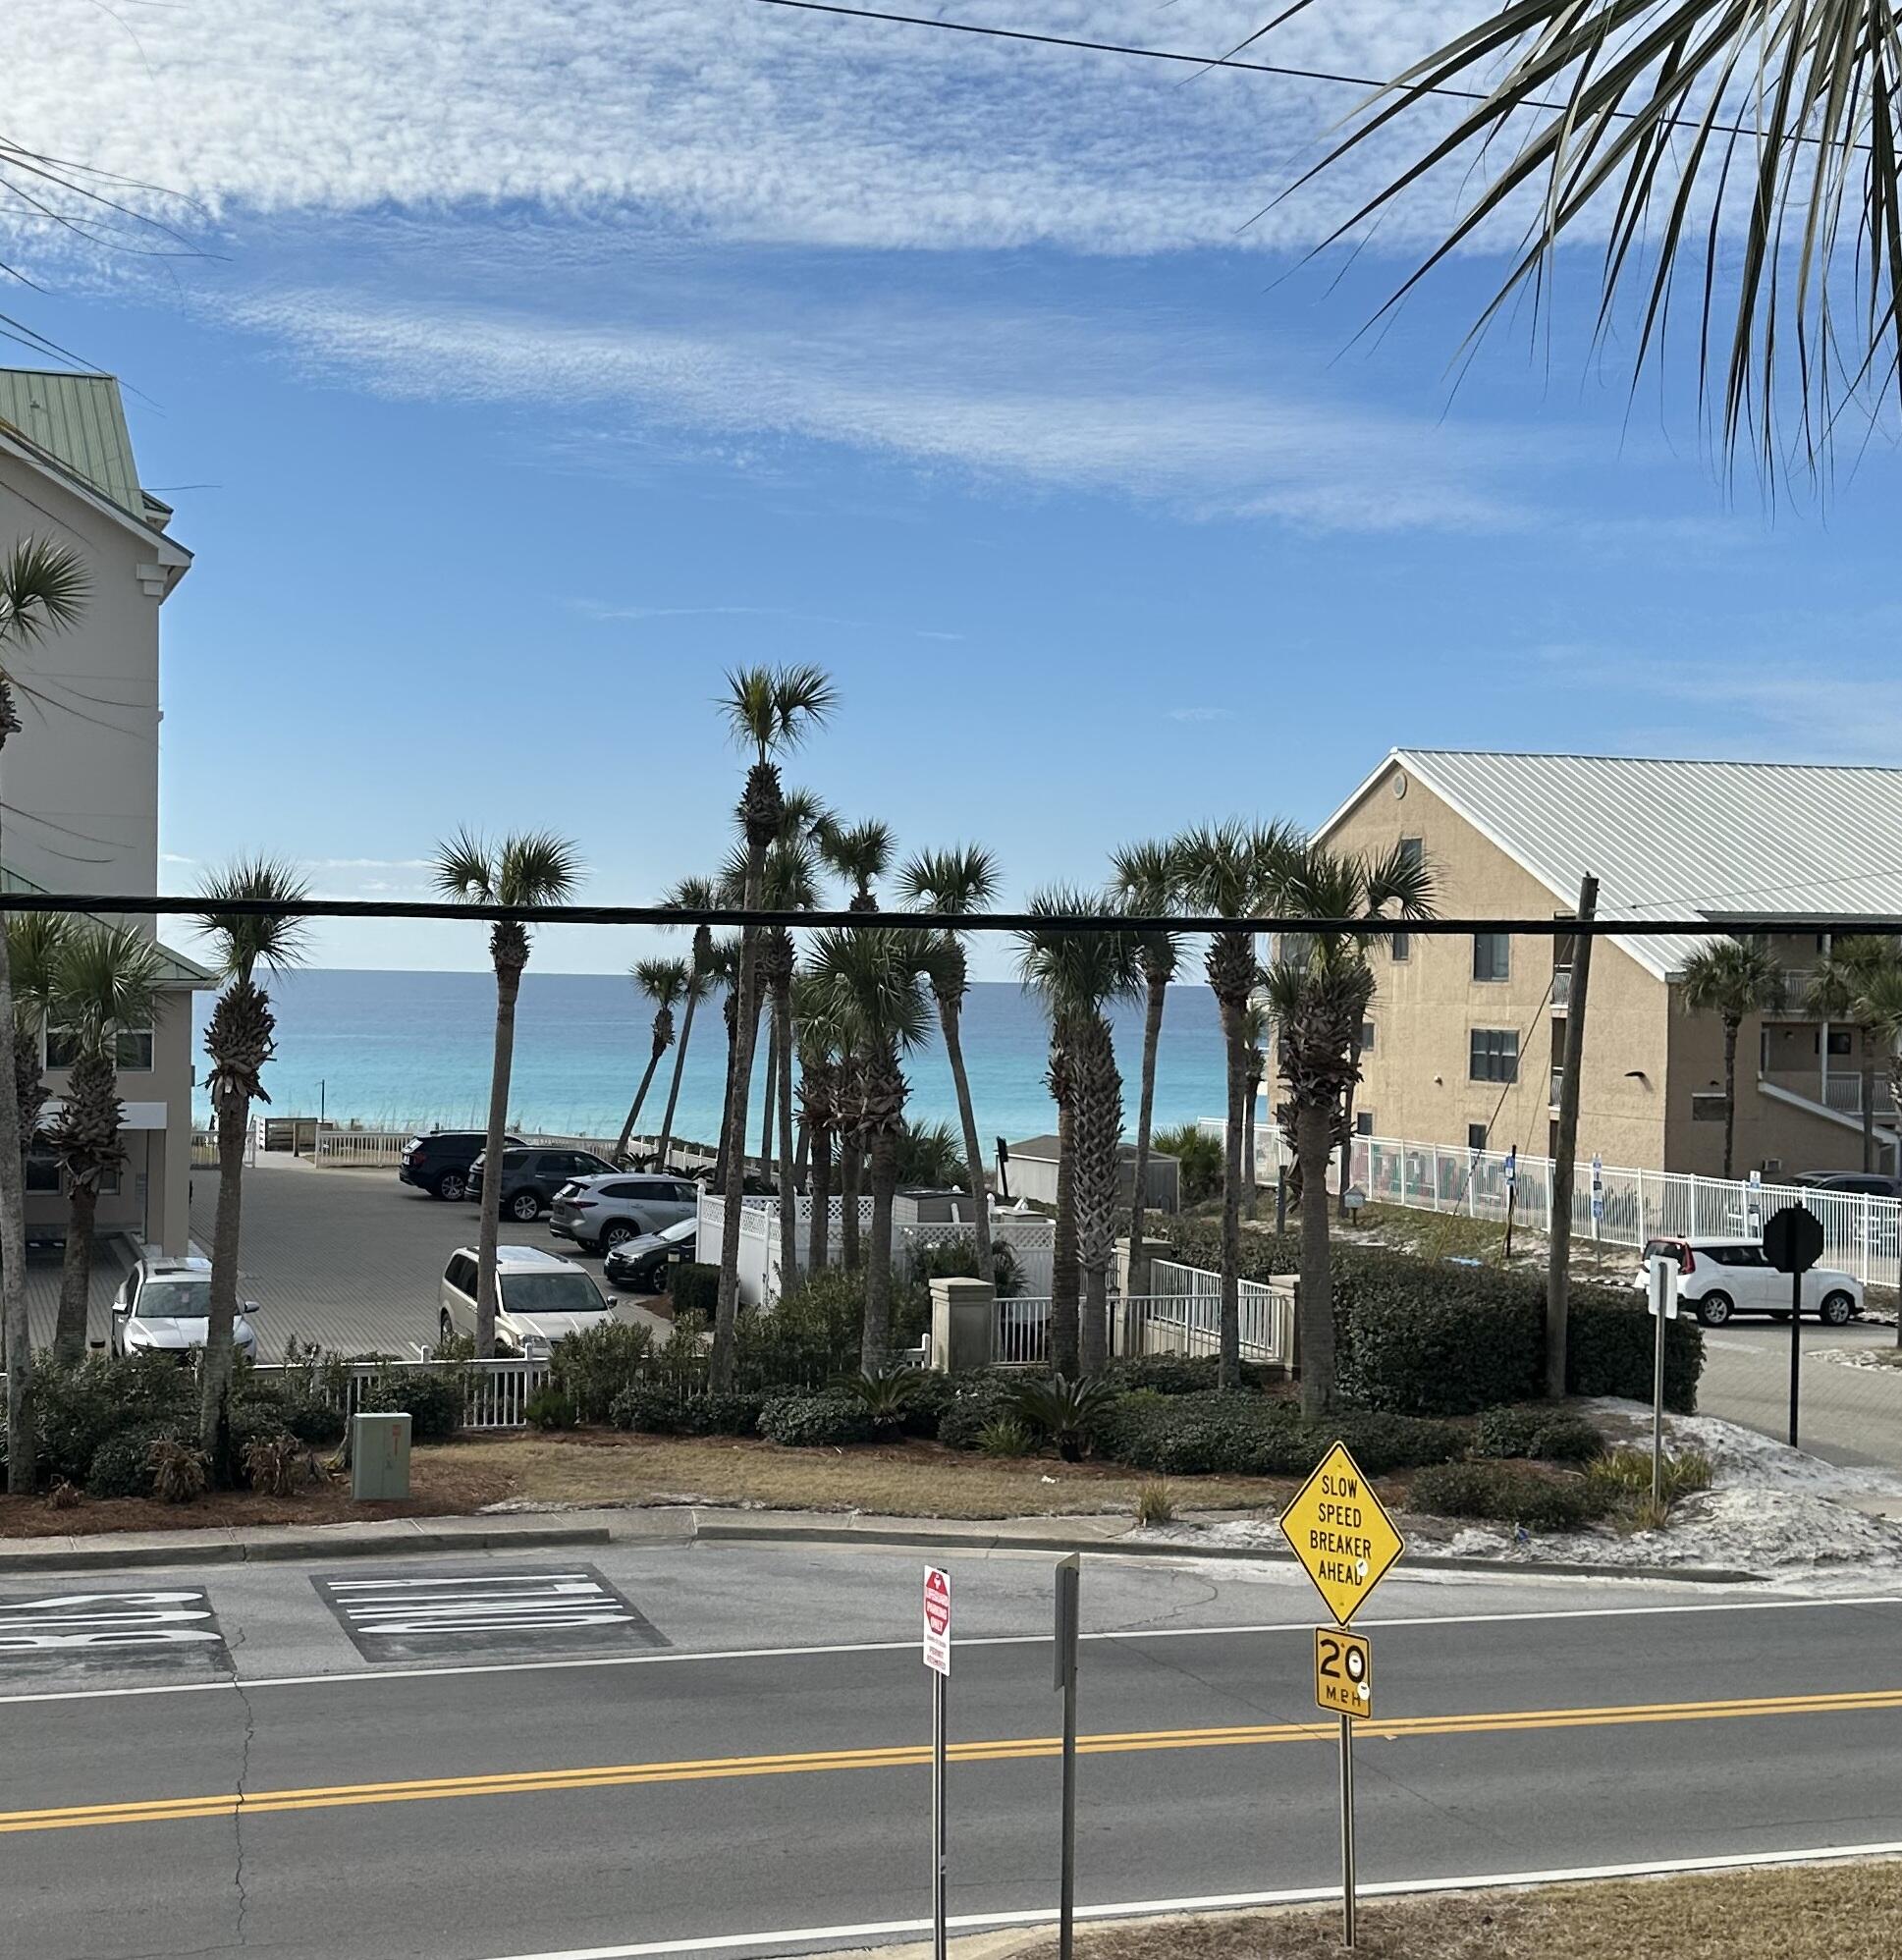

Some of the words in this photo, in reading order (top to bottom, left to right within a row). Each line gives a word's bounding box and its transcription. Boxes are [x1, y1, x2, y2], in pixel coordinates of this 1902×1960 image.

[1322, 1475, 1357, 1498] SLOW
[1318, 1502, 1362, 1528] SPEED
[1310, 1530, 1372, 1559] BREAKER
[0, 1592, 222, 1650] BUS
[327, 1574, 635, 1634] ONLY
[1320, 1639, 1366, 1683] 20
